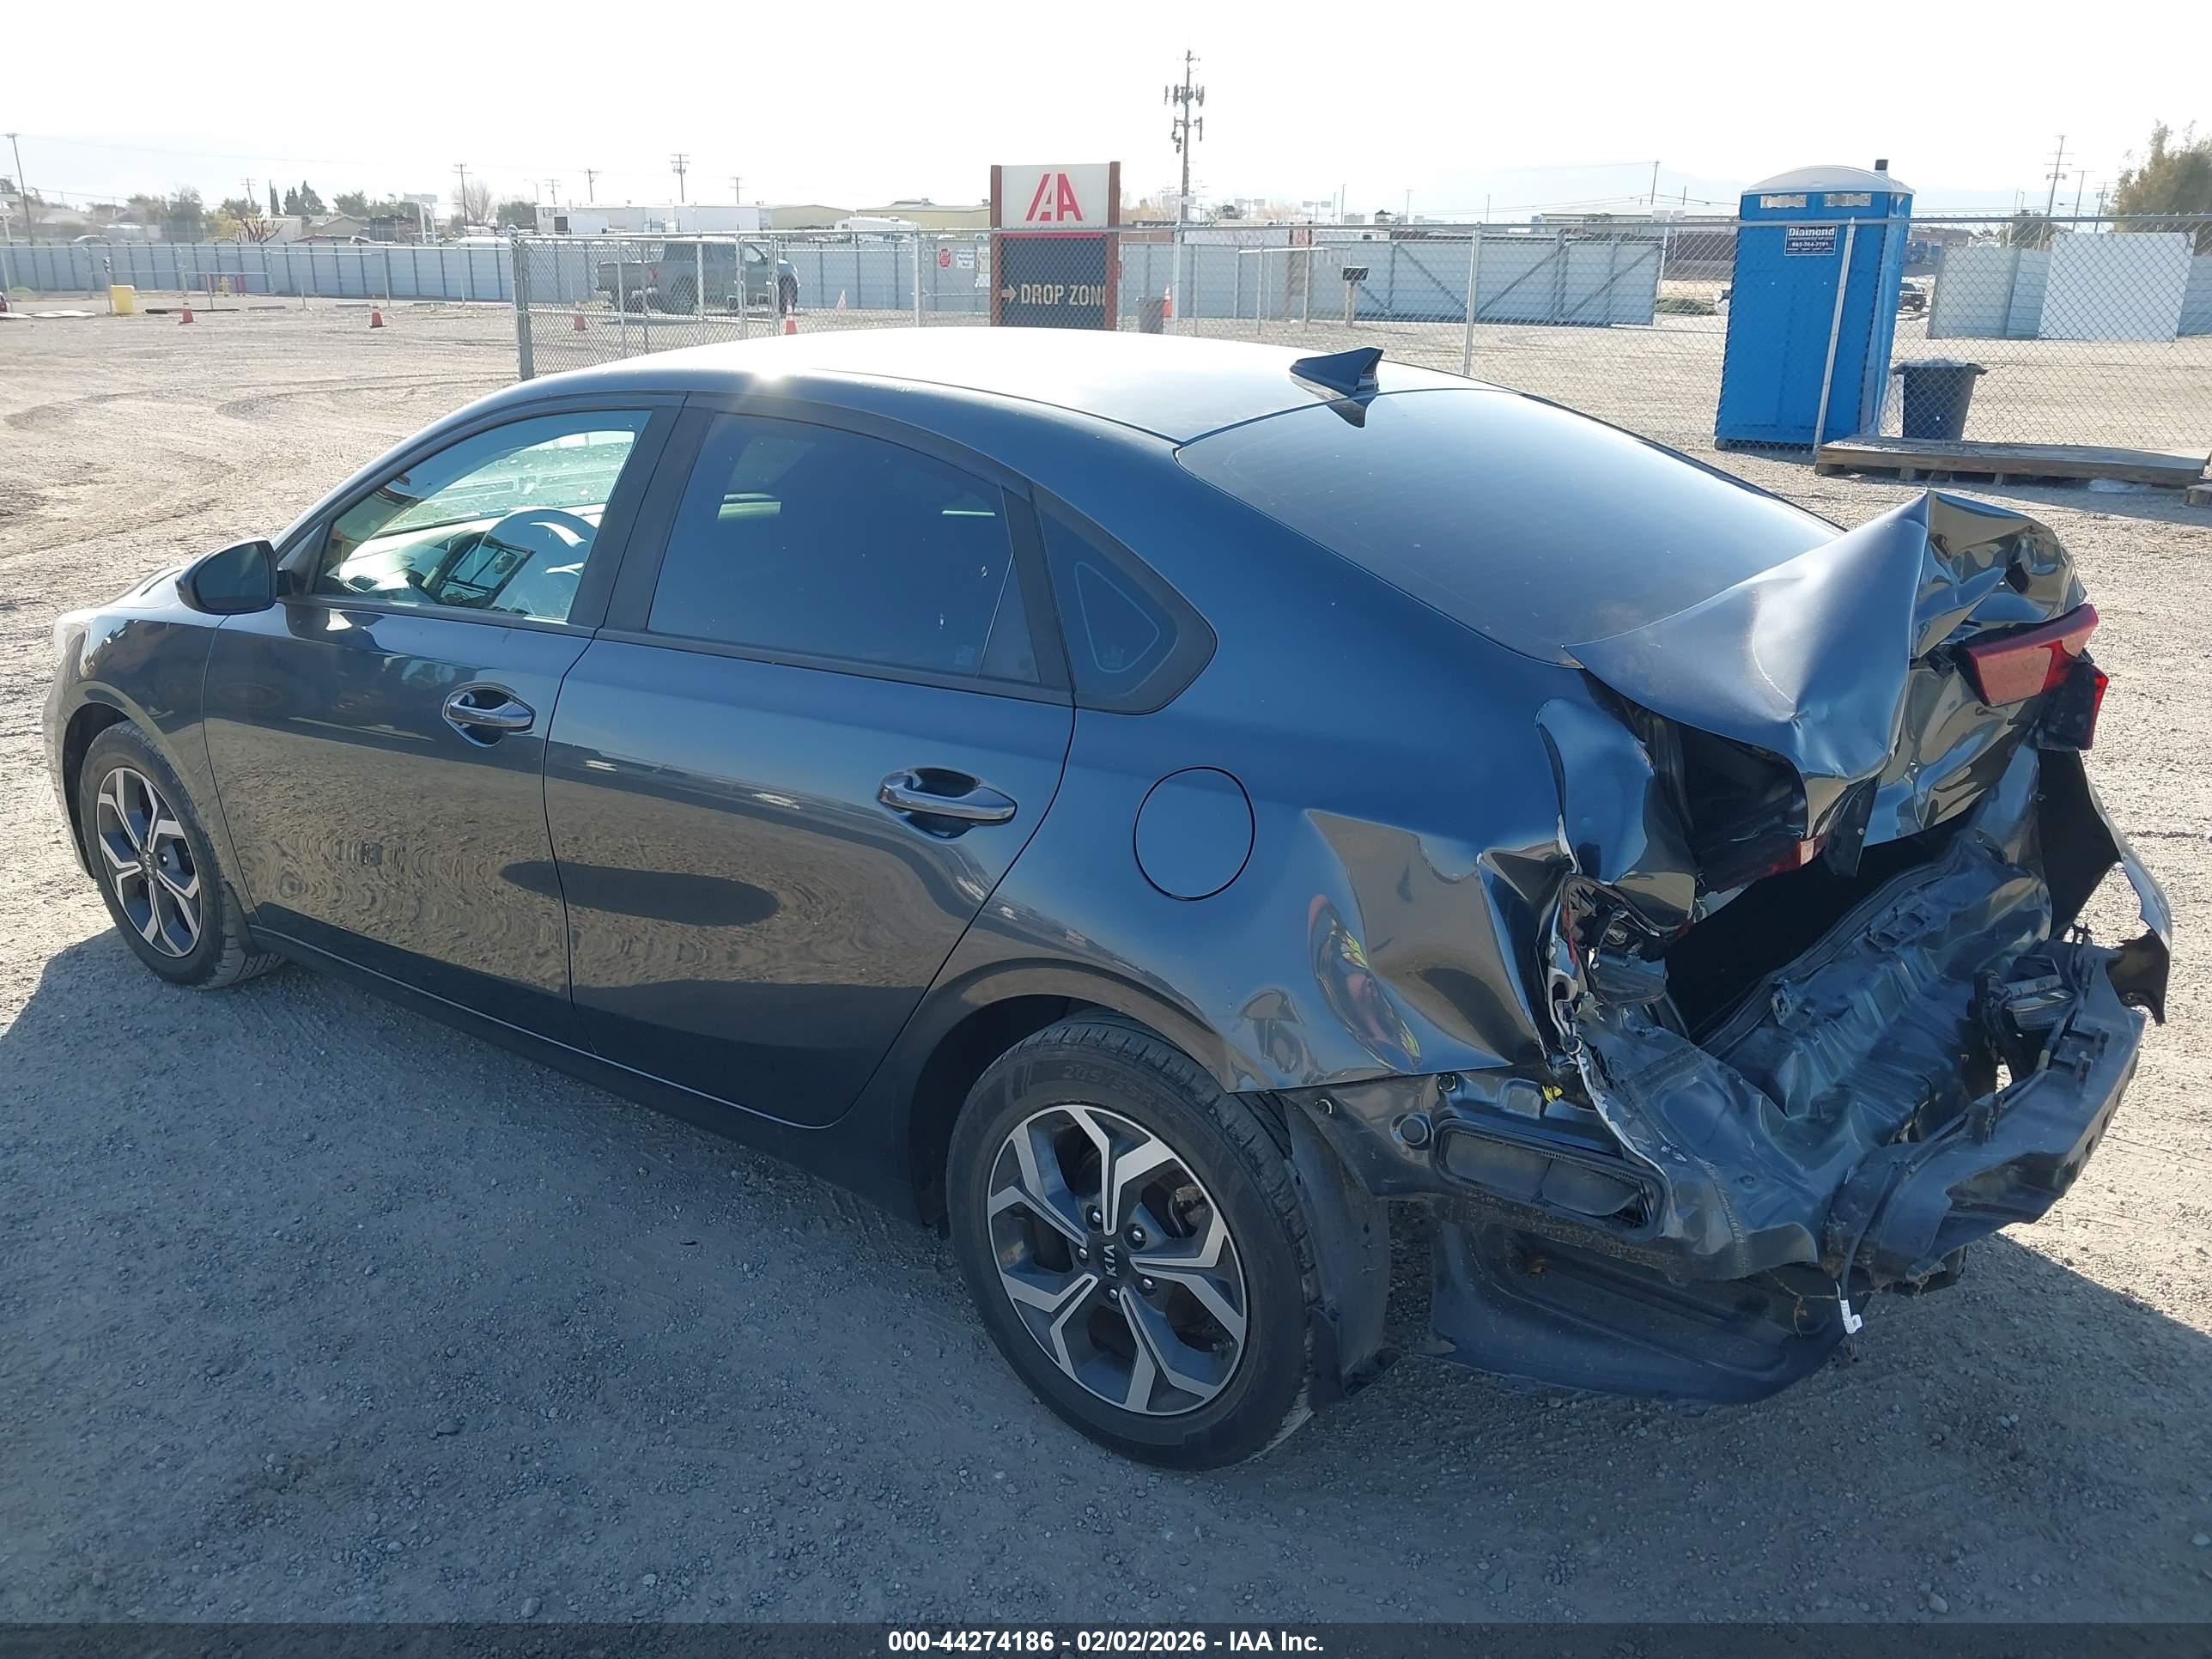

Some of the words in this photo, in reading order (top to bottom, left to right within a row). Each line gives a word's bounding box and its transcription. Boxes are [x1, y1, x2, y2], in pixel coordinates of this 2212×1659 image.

[1788, 227, 1836, 237] Diamond
[1020, 283, 1065, 305] DROP
[1068, 284, 1106, 307] ZON
[1103, 1244, 1118, 1278] KIA
